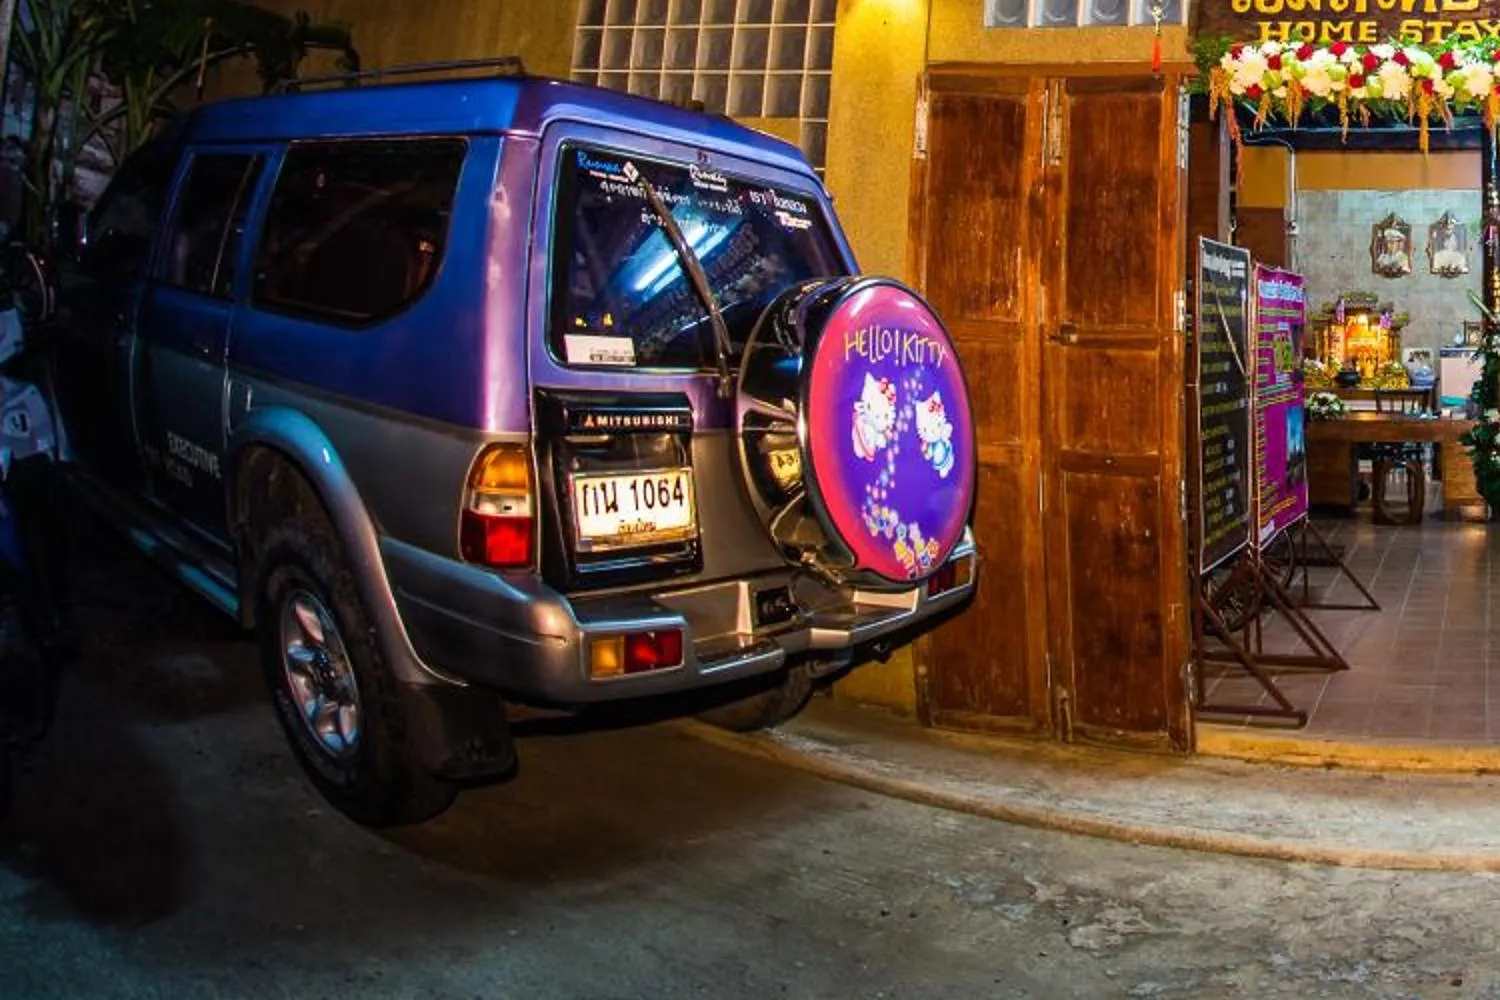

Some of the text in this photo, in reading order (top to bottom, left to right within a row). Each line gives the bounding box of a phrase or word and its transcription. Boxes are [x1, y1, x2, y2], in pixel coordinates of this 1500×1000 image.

[1257, 19, 1378, 43] HOME
[597, 414, 681, 427] MITSUBISHI
[630, 475, 685, 512] 1064
